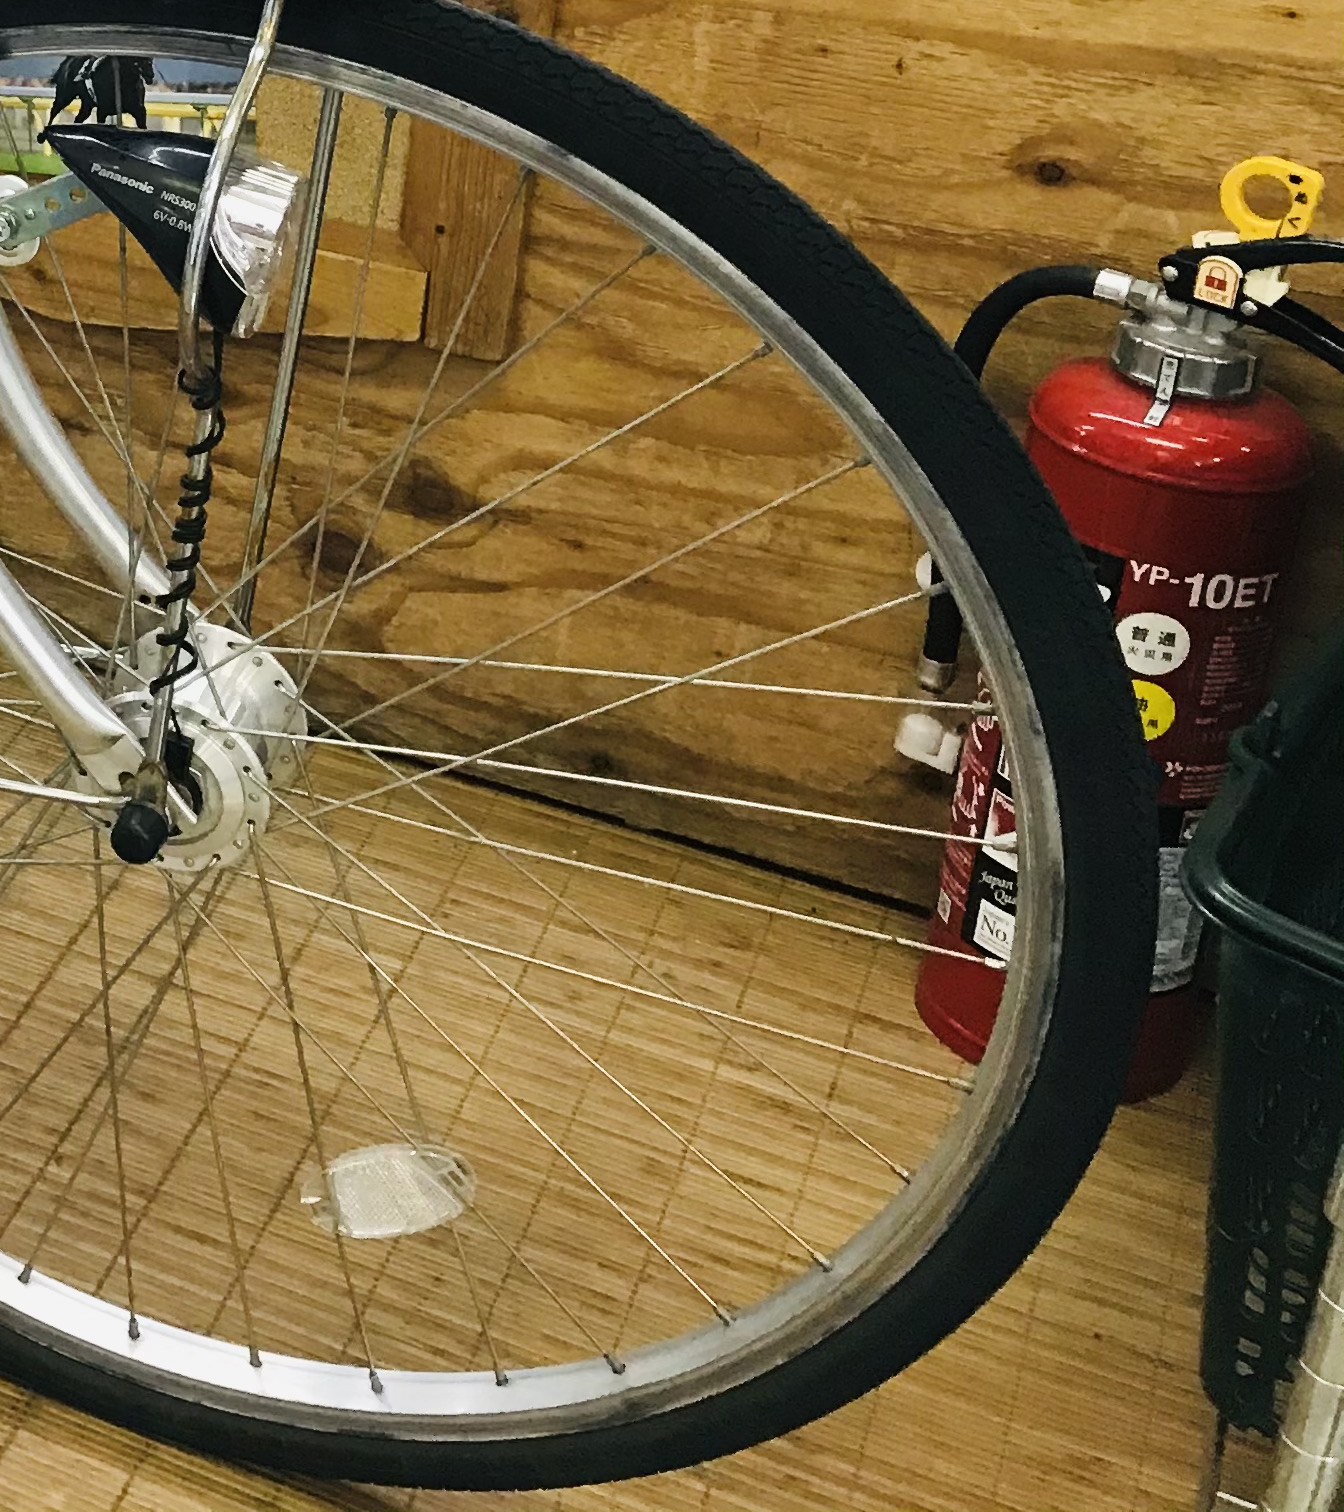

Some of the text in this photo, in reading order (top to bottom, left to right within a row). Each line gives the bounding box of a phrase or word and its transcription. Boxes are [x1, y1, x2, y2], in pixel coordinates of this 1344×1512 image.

[90, 162, 155, 194] Panasonic
[1129, 558, 1280, 610] YP-10ET
[980, 914, 1010, 946] No.
